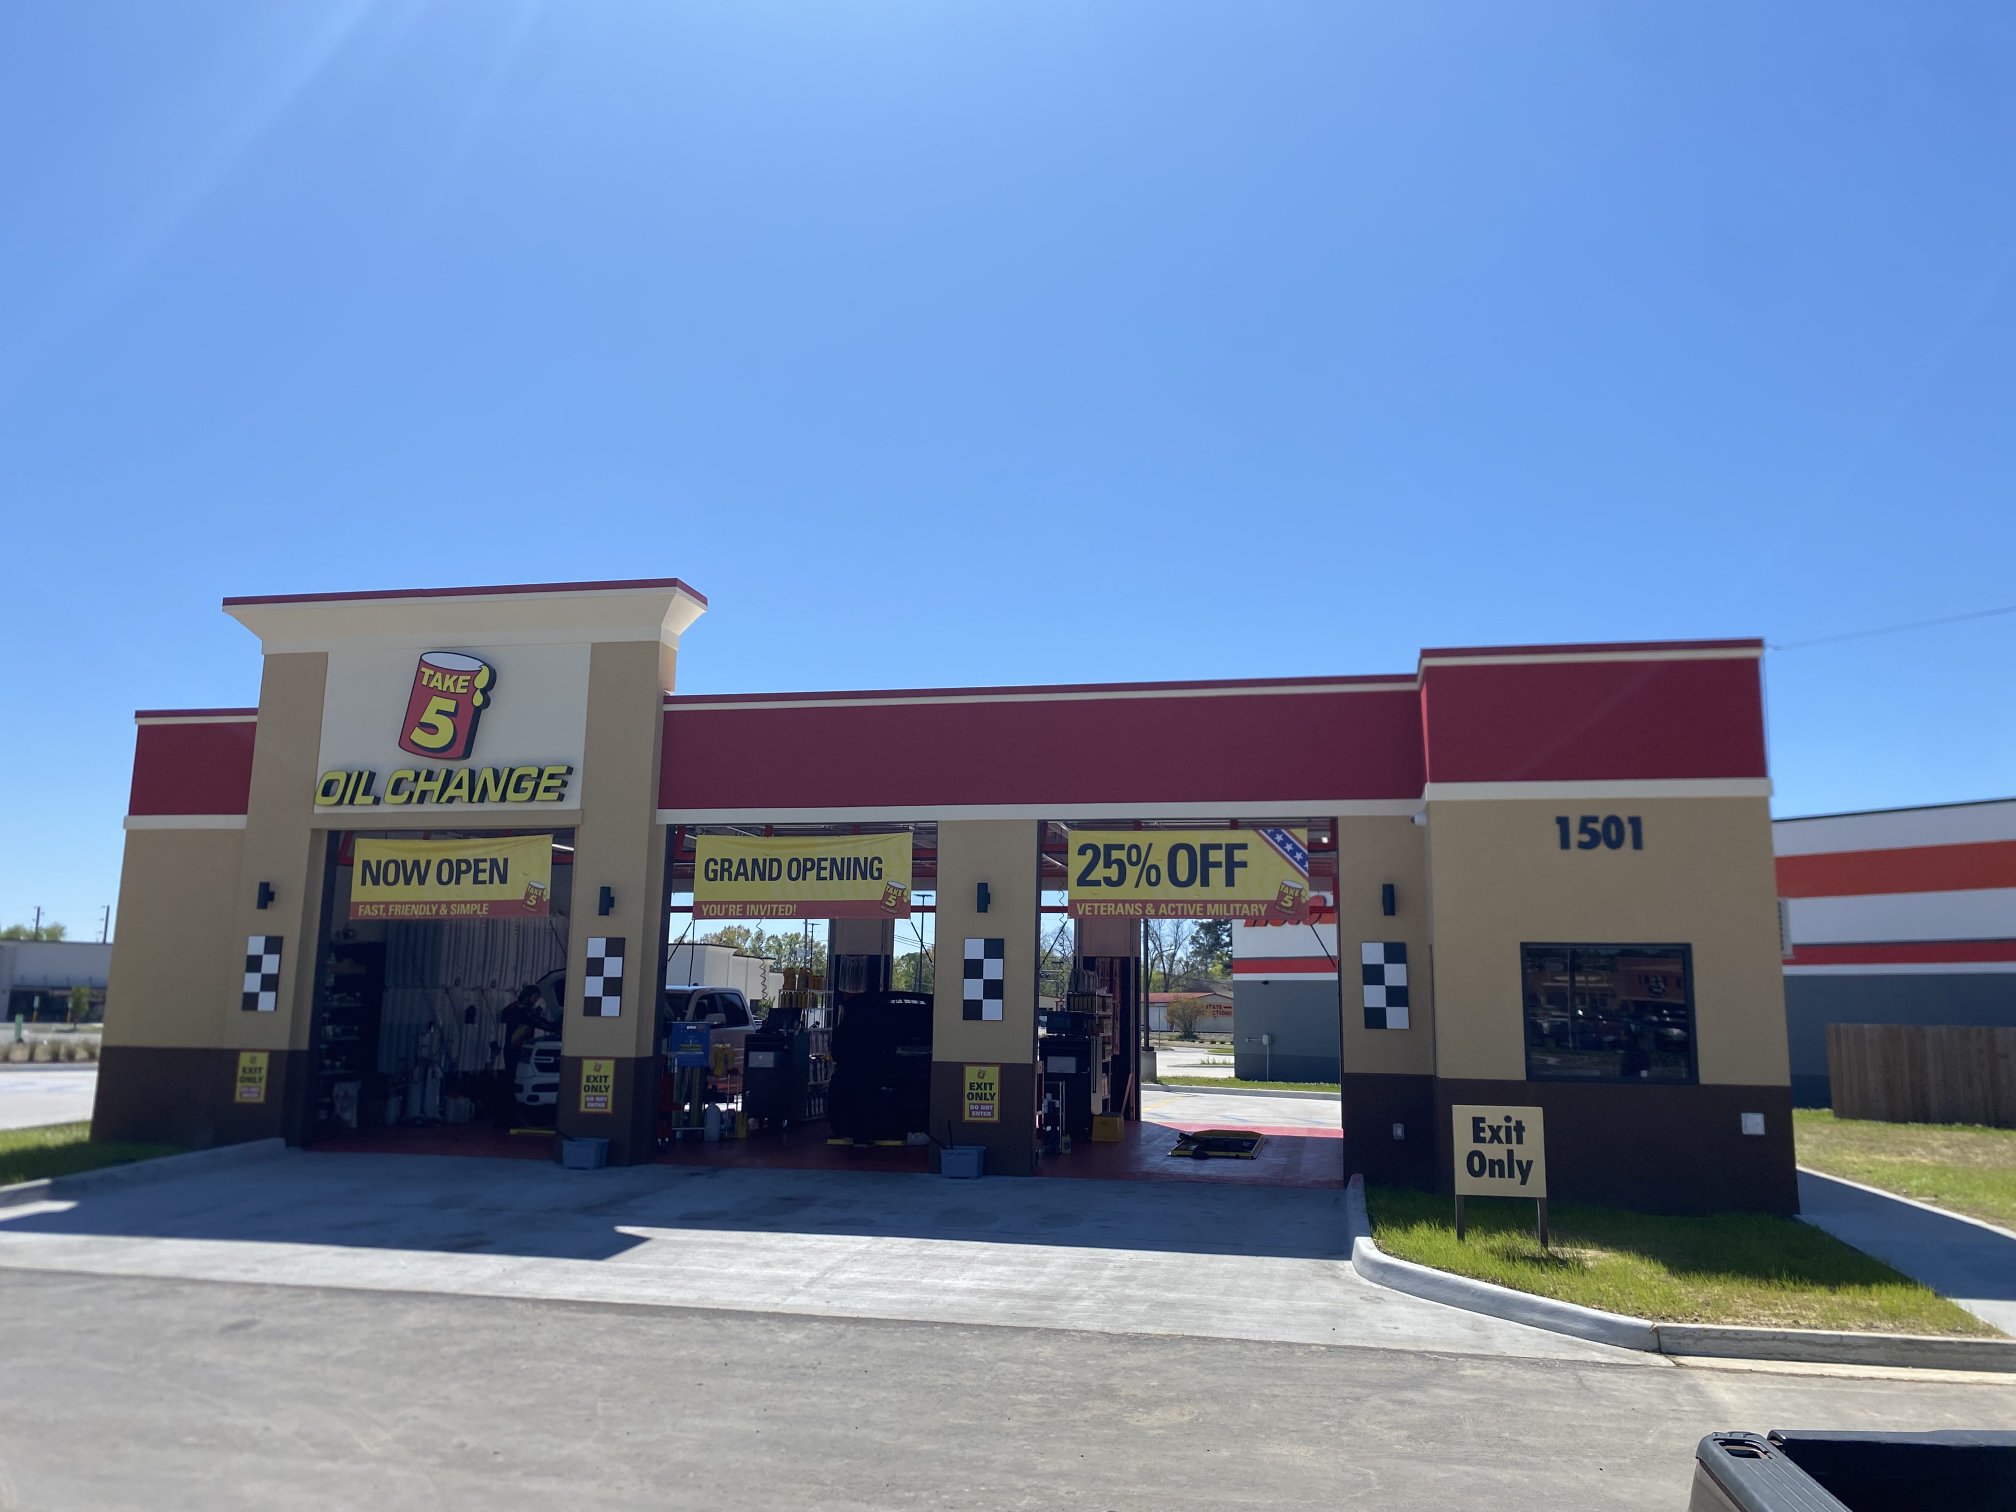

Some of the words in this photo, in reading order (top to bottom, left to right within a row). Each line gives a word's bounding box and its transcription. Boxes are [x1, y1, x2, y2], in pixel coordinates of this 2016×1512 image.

[420, 667, 471, 694] TAKE
[409, 695, 458, 750] 5
[314, 769, 381, 807] OIL
[383, 765, 573, 805] CHANGE
[1555, 814, 1643, 851] 1501
[360, 858, 431, 887] NOW
[436, 857, 509, 885] OPEN
[704, 857, 782, 882] GRAND
[787, 856, 883, 881] OPENING
[1076, 843, 1161, 888] 25%
[1167, 843, 1248, 888] OFF
[886, 885, 903, 897] TAKE
[1280, 884, 1301, 897] TAKE
[526, 894, 538, 906] 5
[885, 894, 897, 907] 5
[1280, 895, 1293, 907] 5
[358, 904, 386, 918] FAST,
[388, 904, 438, 917] FRIENDLY
[440, 903, 448, 916] &
[450, 903, 489, 916] SIMPLE
[702, 904, 743, 916] YOU'RE
[746, 904, 797, 916] INVITED!
[1076, 903, 1142, 916] VETERANS
[1147, 903, 1156, 916] &
[1158, 903, 1204, 916] ACTIVE
[1206, 903, 1268, 917] MILITARY
[586, 1075, 609, 1083] EXIT
[583, 1084, 610, 1093] ONLY
[969, 1082, 994, 1091] EXIT
[966, 1092, 996, 1101] ONLY
[1472, 1115, 1526, 1145] Exit
[1466, 1149, 1534, 1186] Only
